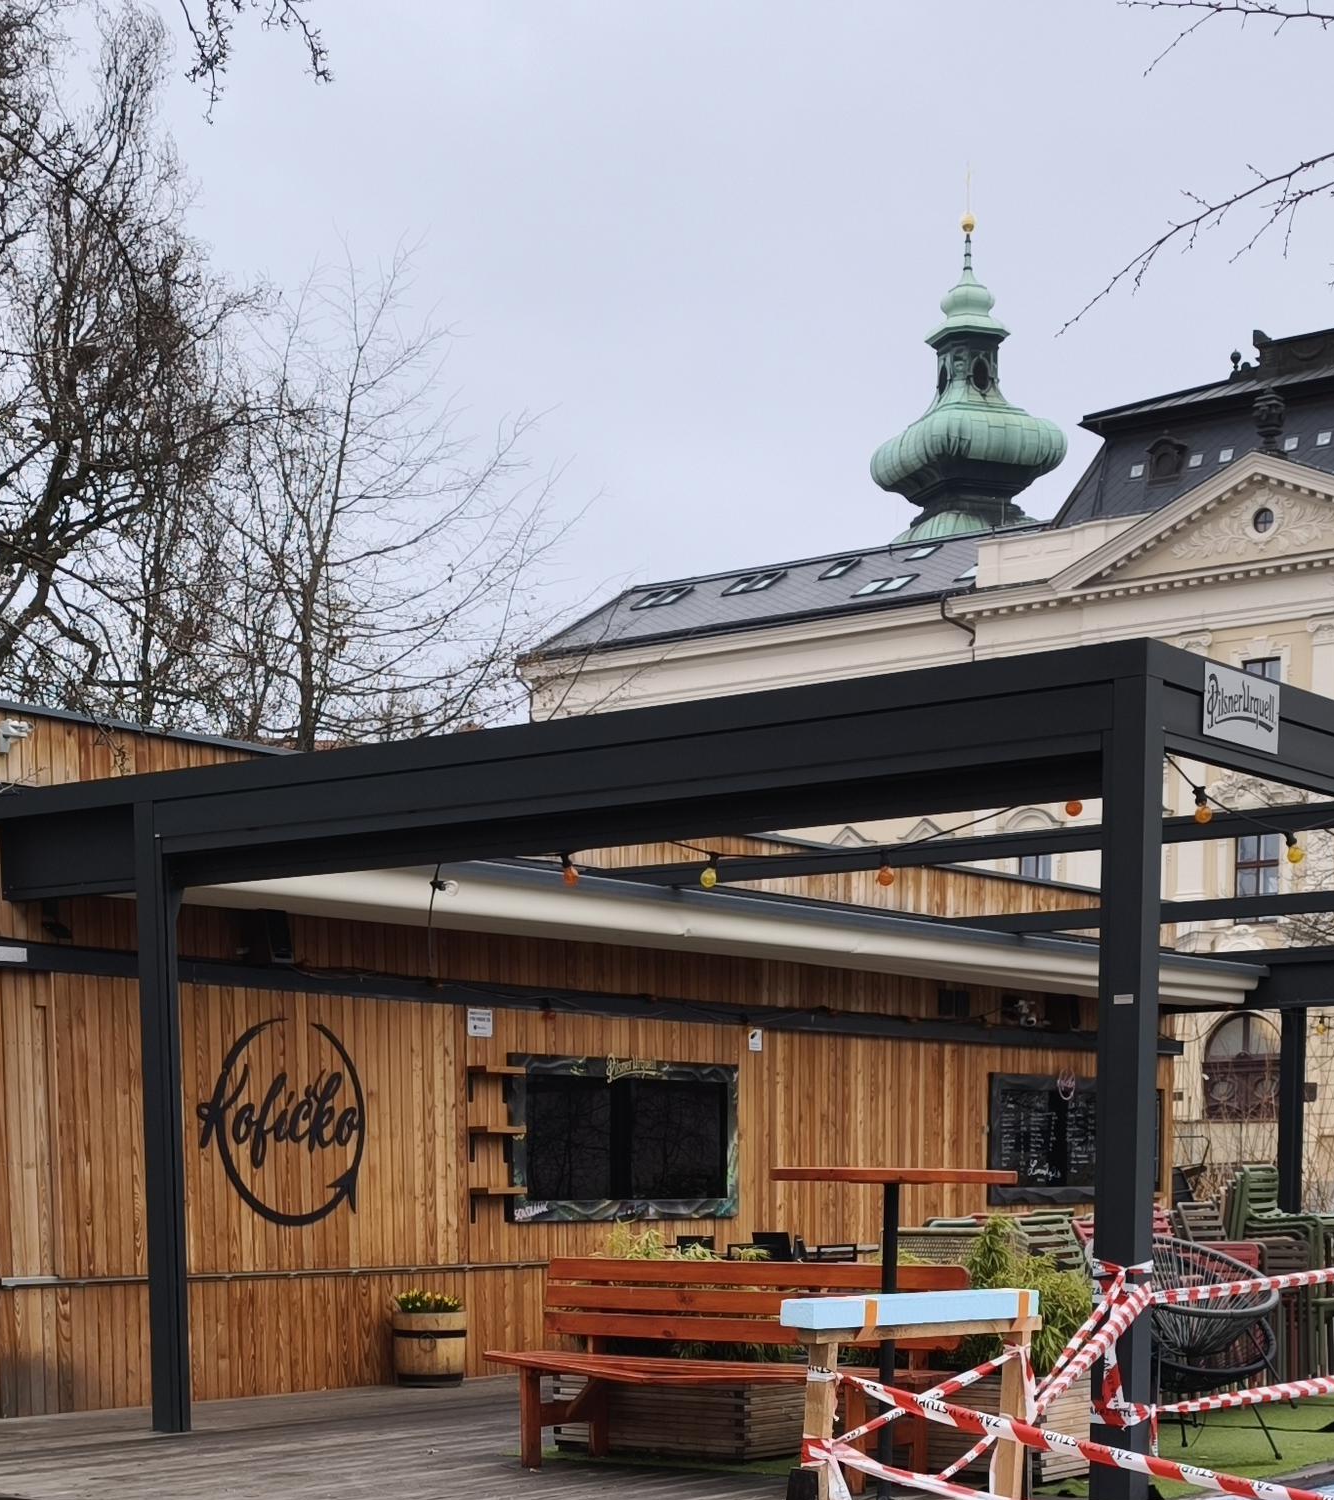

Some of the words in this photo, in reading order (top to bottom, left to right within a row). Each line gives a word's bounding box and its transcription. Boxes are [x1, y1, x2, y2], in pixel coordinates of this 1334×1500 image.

[1207, 673, 1243, 729] Pilsner
[1242, 680, 1275, 730] Urquell
[197, 1063, 359, 1169] Kofíčko
